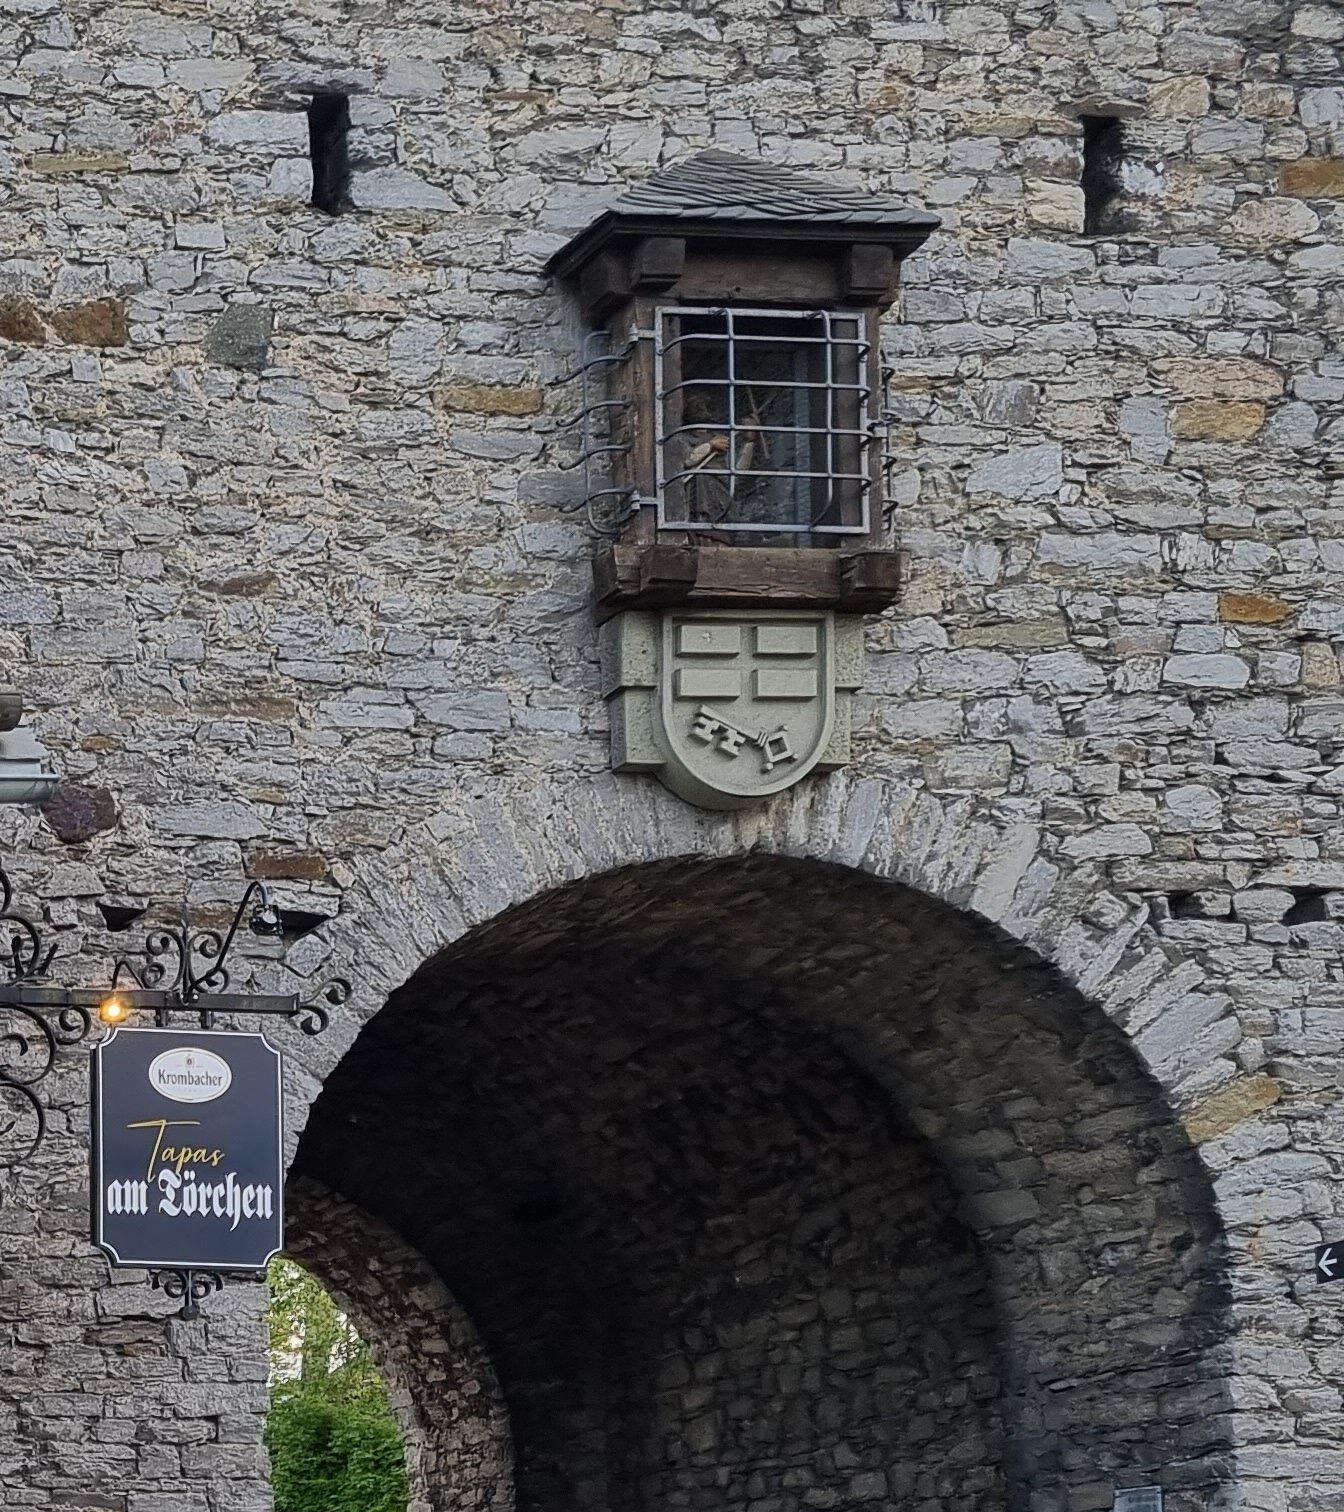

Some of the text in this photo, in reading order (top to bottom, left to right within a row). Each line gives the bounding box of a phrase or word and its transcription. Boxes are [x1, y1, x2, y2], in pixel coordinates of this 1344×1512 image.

[158, 1069, 223, 1087] Krombacher
[126, 1119, 225, 1183] Tapas
[107, 1168, 275, 1231] am Törchen
